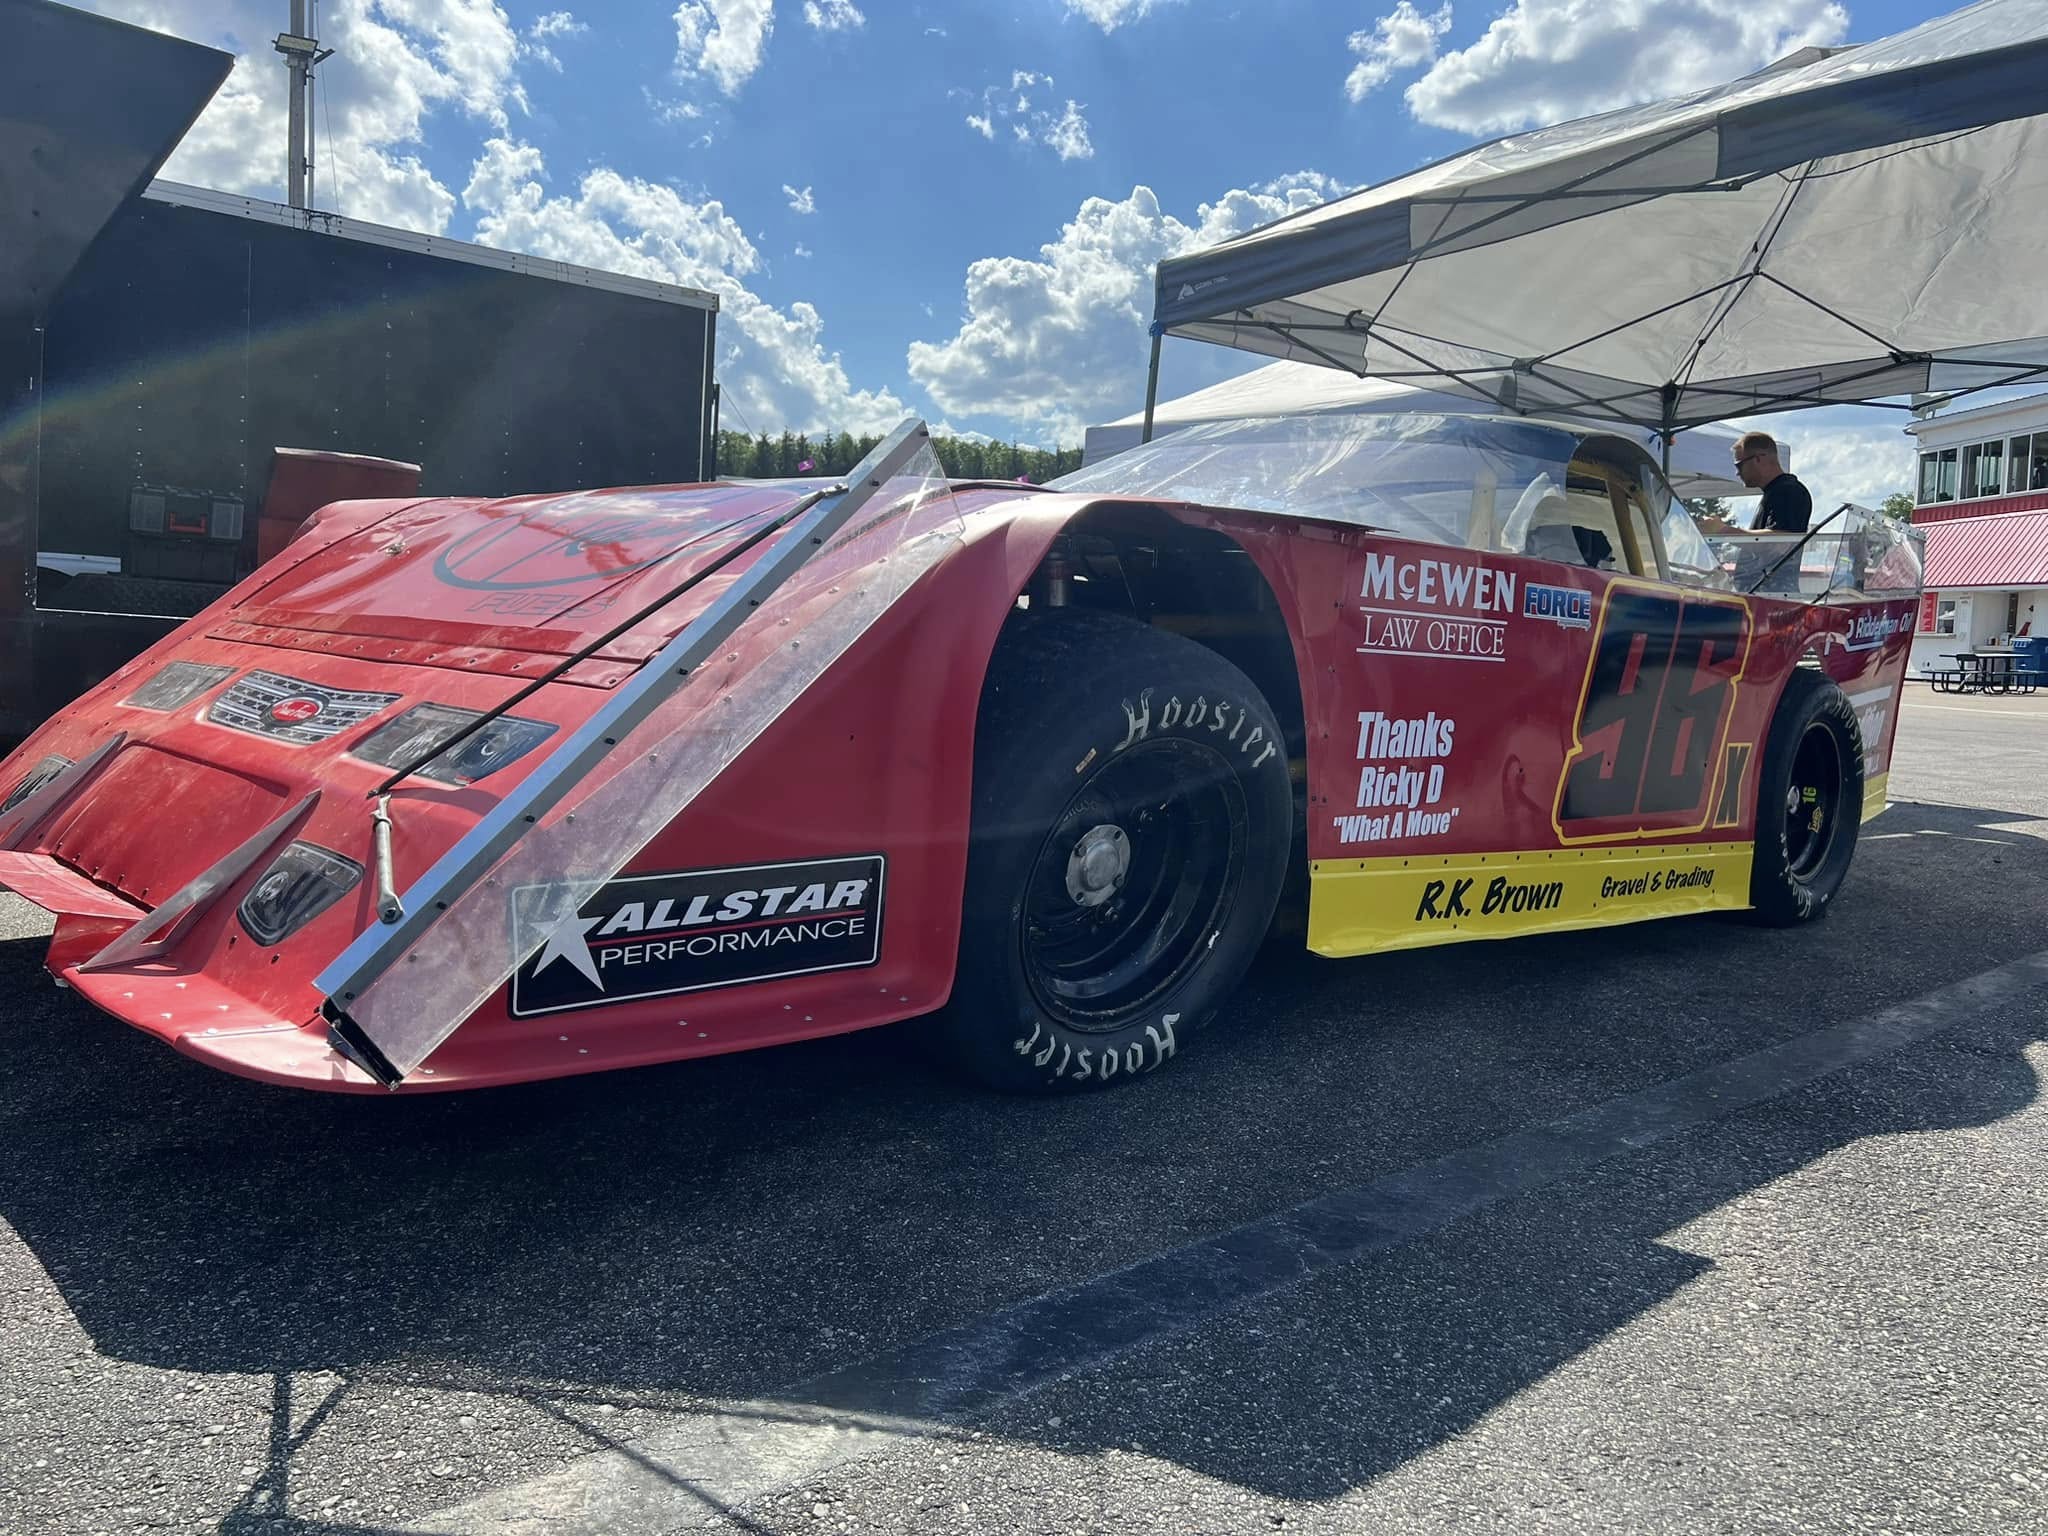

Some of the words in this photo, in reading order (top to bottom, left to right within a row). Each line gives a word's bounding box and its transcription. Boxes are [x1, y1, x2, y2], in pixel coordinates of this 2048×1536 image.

[1360, 552, 1516, 613] McEWEN
[1524, 584, 1592, 621] FORCE
[1363, 614, 1419, 649] LAW
[1427, 621, 1506, 656] OFFICE
[1113, 687, 1276, 768] Hoosier
[1559, 593, 1745, 820] 96
[1356, 711, 1456, 760] Thanks
[1357, 765, 1427, 808] Ricky
[1425, 764, 1445, 804] D
[1333, 814, 1388, 844] "What
[1389, 813, 1403, 839] A
[1406, 807, 1460, 837] Move"
[1415, 878, 1472, 921] R.K.
[1480, 875, 1564, 914] Brown
[1601, 871, 1649, 898] Gravel
[1650, 870, 1662, 892] &
[1665, 866, 1715, 892] Grading
[597, 878, 868, 936] ALLSTAR
[600, 916, 866, 969] PERFORMANCE
[1014, 1011, 1181, 1082] Hoosier
